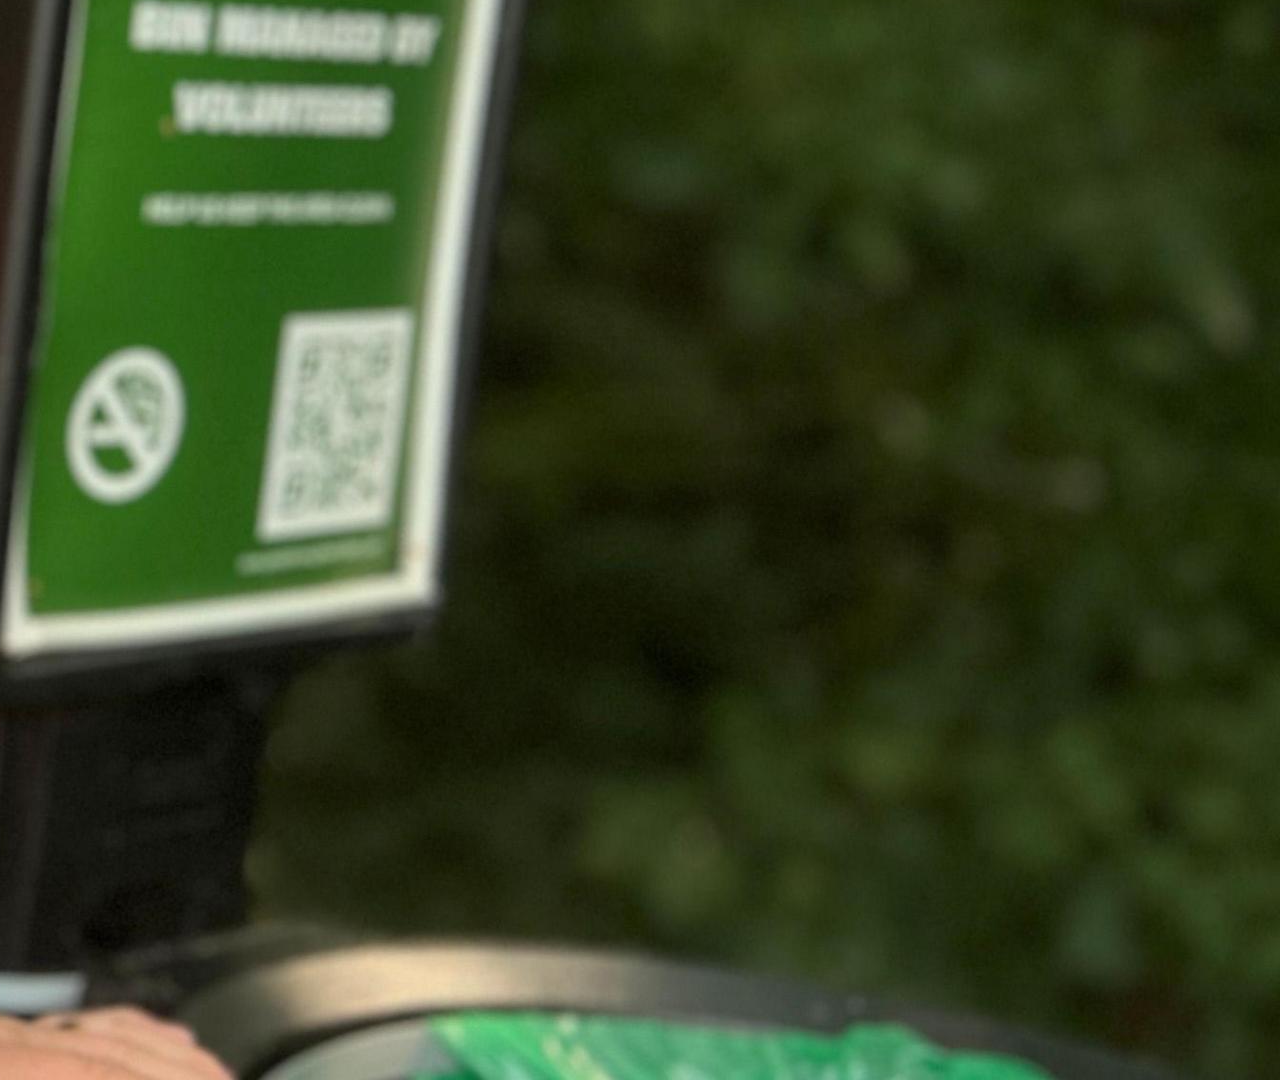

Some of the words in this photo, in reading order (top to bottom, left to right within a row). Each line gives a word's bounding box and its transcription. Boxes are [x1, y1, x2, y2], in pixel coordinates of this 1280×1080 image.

[216, 5, 386, 62] MANAGED
[391, 14, 440, 64] BY
[174, 82, 393, 138] VOLUNTEERS
